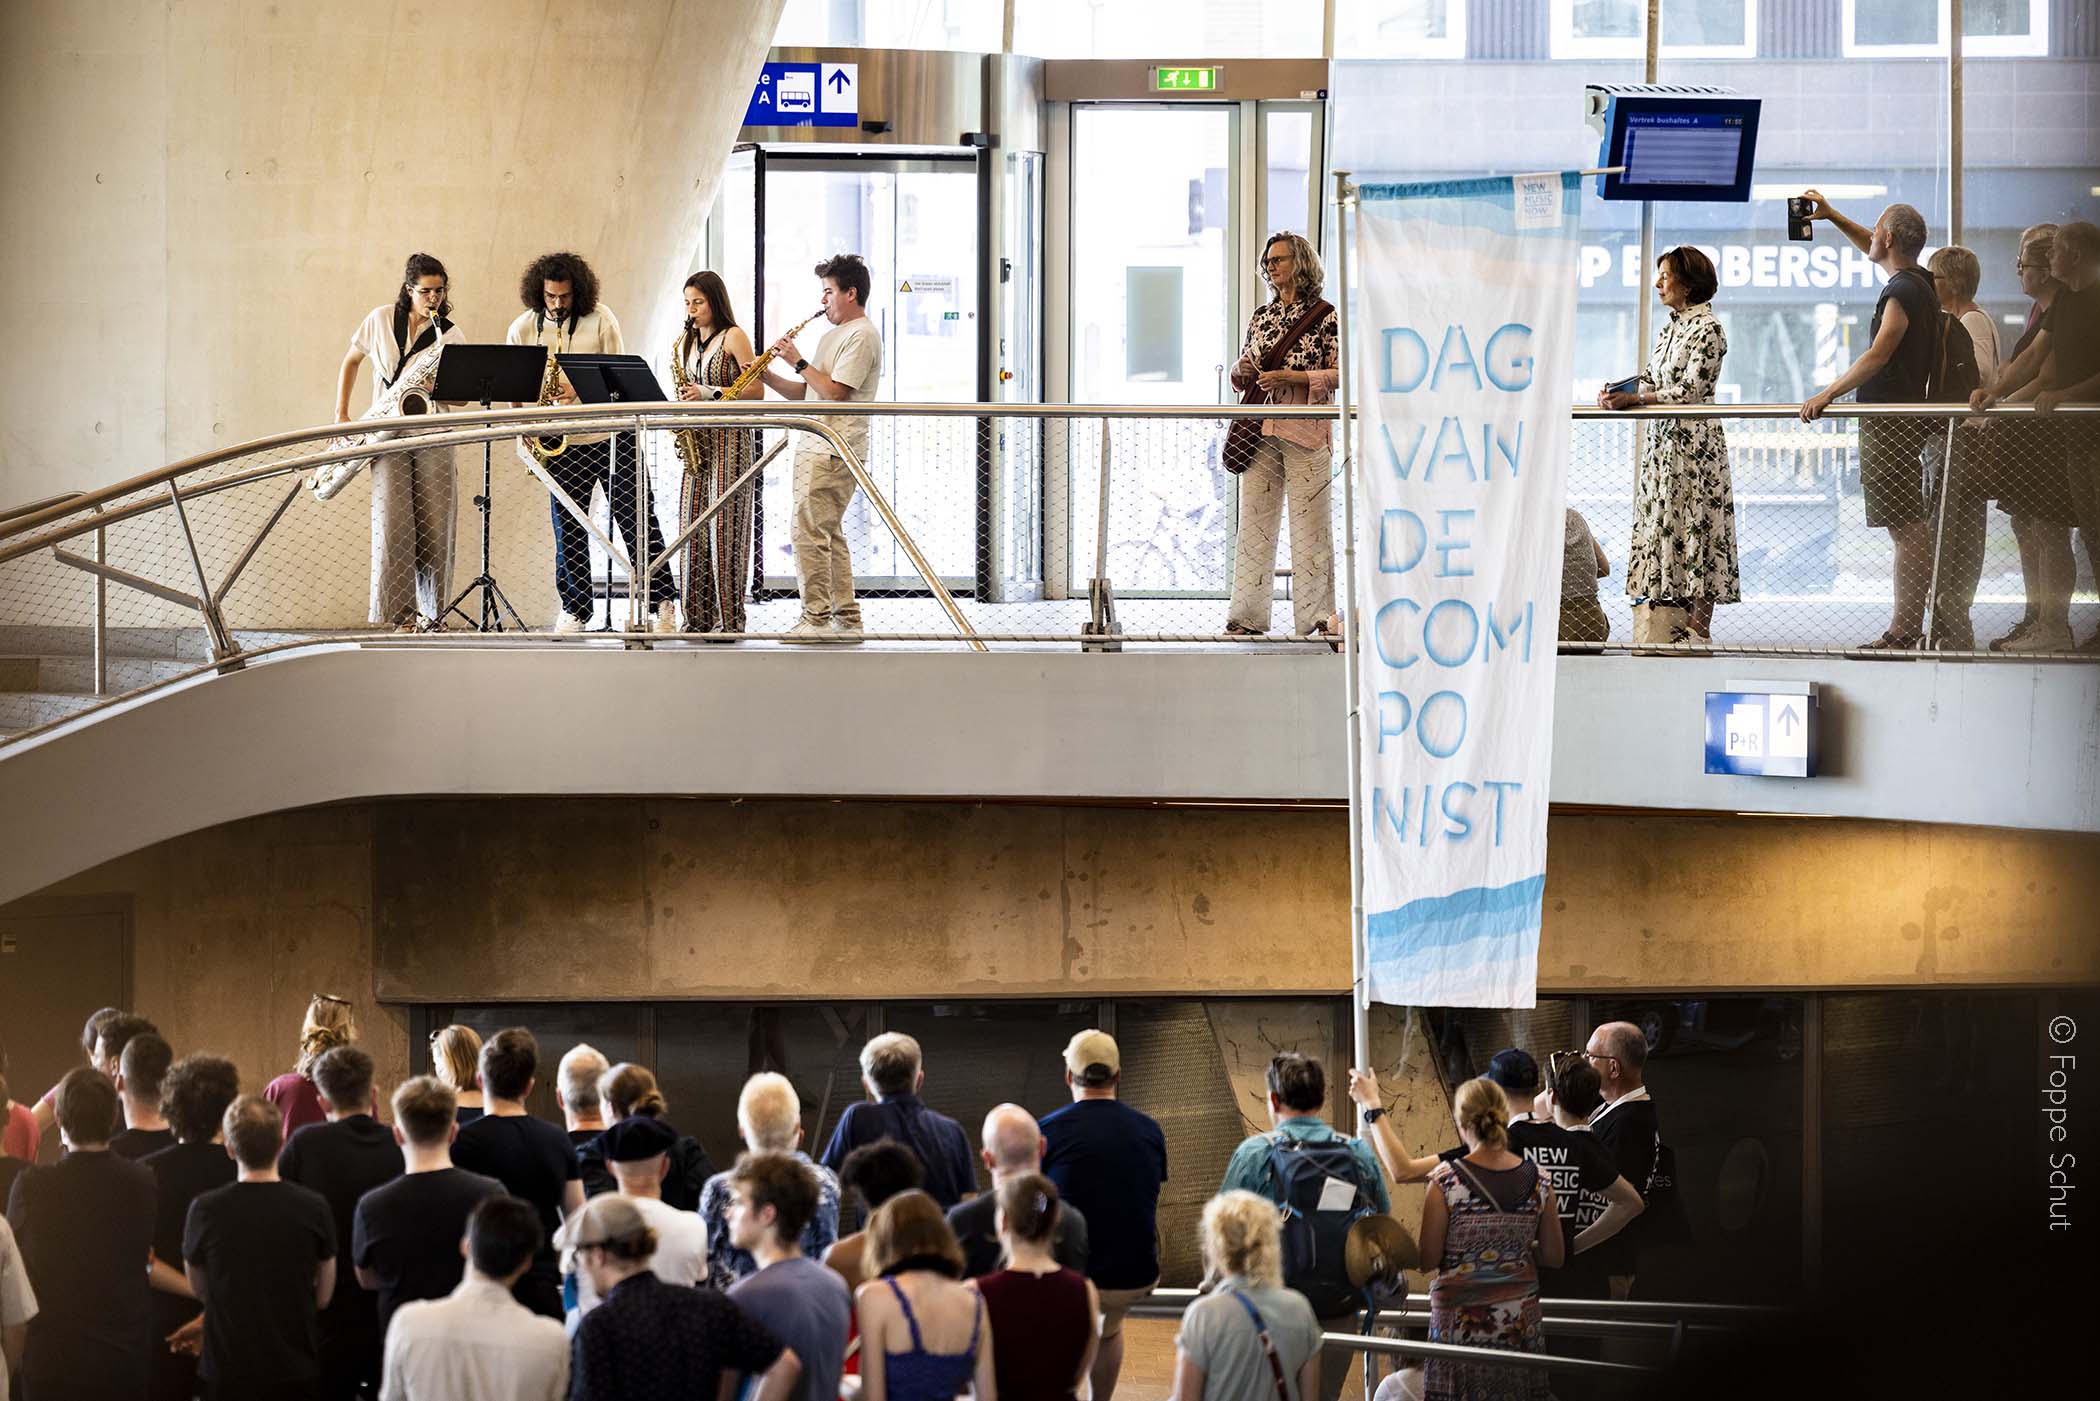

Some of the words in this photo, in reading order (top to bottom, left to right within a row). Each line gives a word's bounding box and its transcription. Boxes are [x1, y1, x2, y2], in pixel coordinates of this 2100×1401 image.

[758, 90, 771, 105] A
[1629, 116, 1655, 124] Vertrek
[1523, 182, 1546, 193] NEW
[1576, 245, 1612, 288] P
[1622, 245, 1938, 288] BBERSH
[1380, 323, 1534, 393] DAG
[1380, 416, 1524, 482] VAN
[1378, 508, 1476, 578] DE
[1375, 598, 1534, 669] COM
[1378, 690, 1467, 759] PO
[1730, 732, 1758, 752] P+R
[1372, 780, 1523, 847] NIST
[1523, 1147, 1568, 1165] NEW
